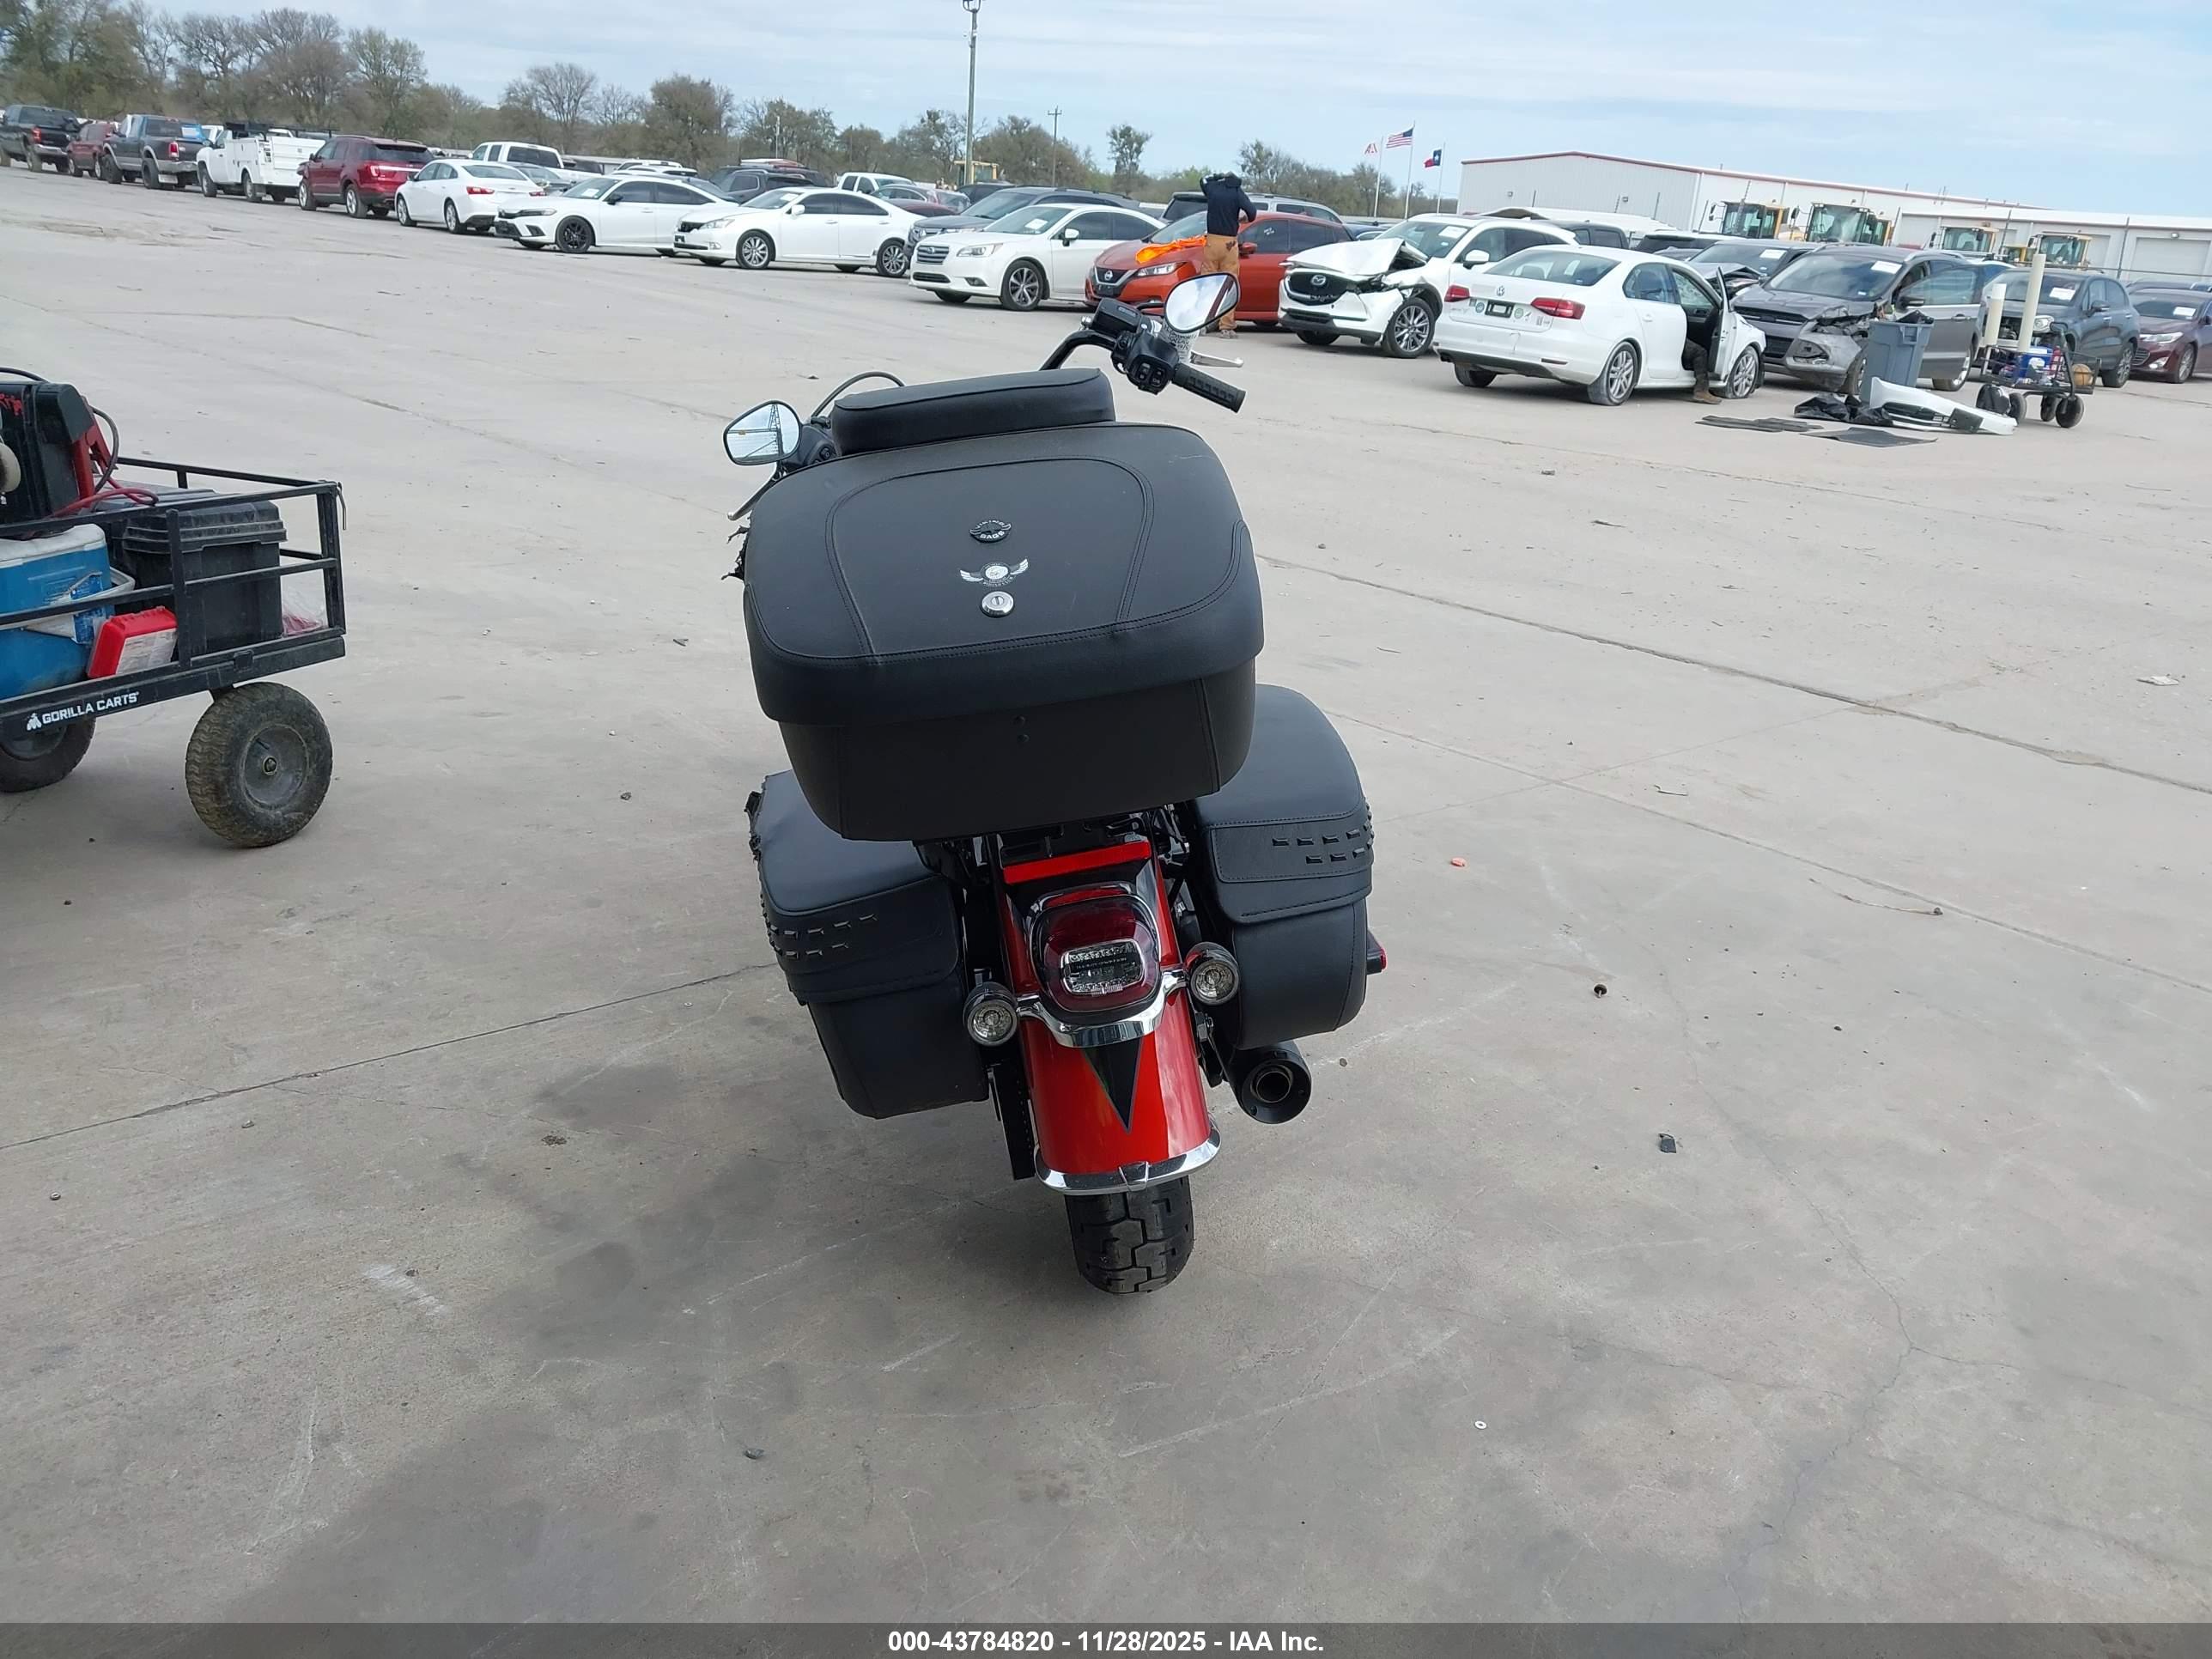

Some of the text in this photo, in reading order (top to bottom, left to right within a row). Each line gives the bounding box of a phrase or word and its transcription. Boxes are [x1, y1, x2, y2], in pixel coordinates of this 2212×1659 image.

[979, 530, 1005, 539] BAGS
[41, 692, 137, 725] GORILLA CARTS
